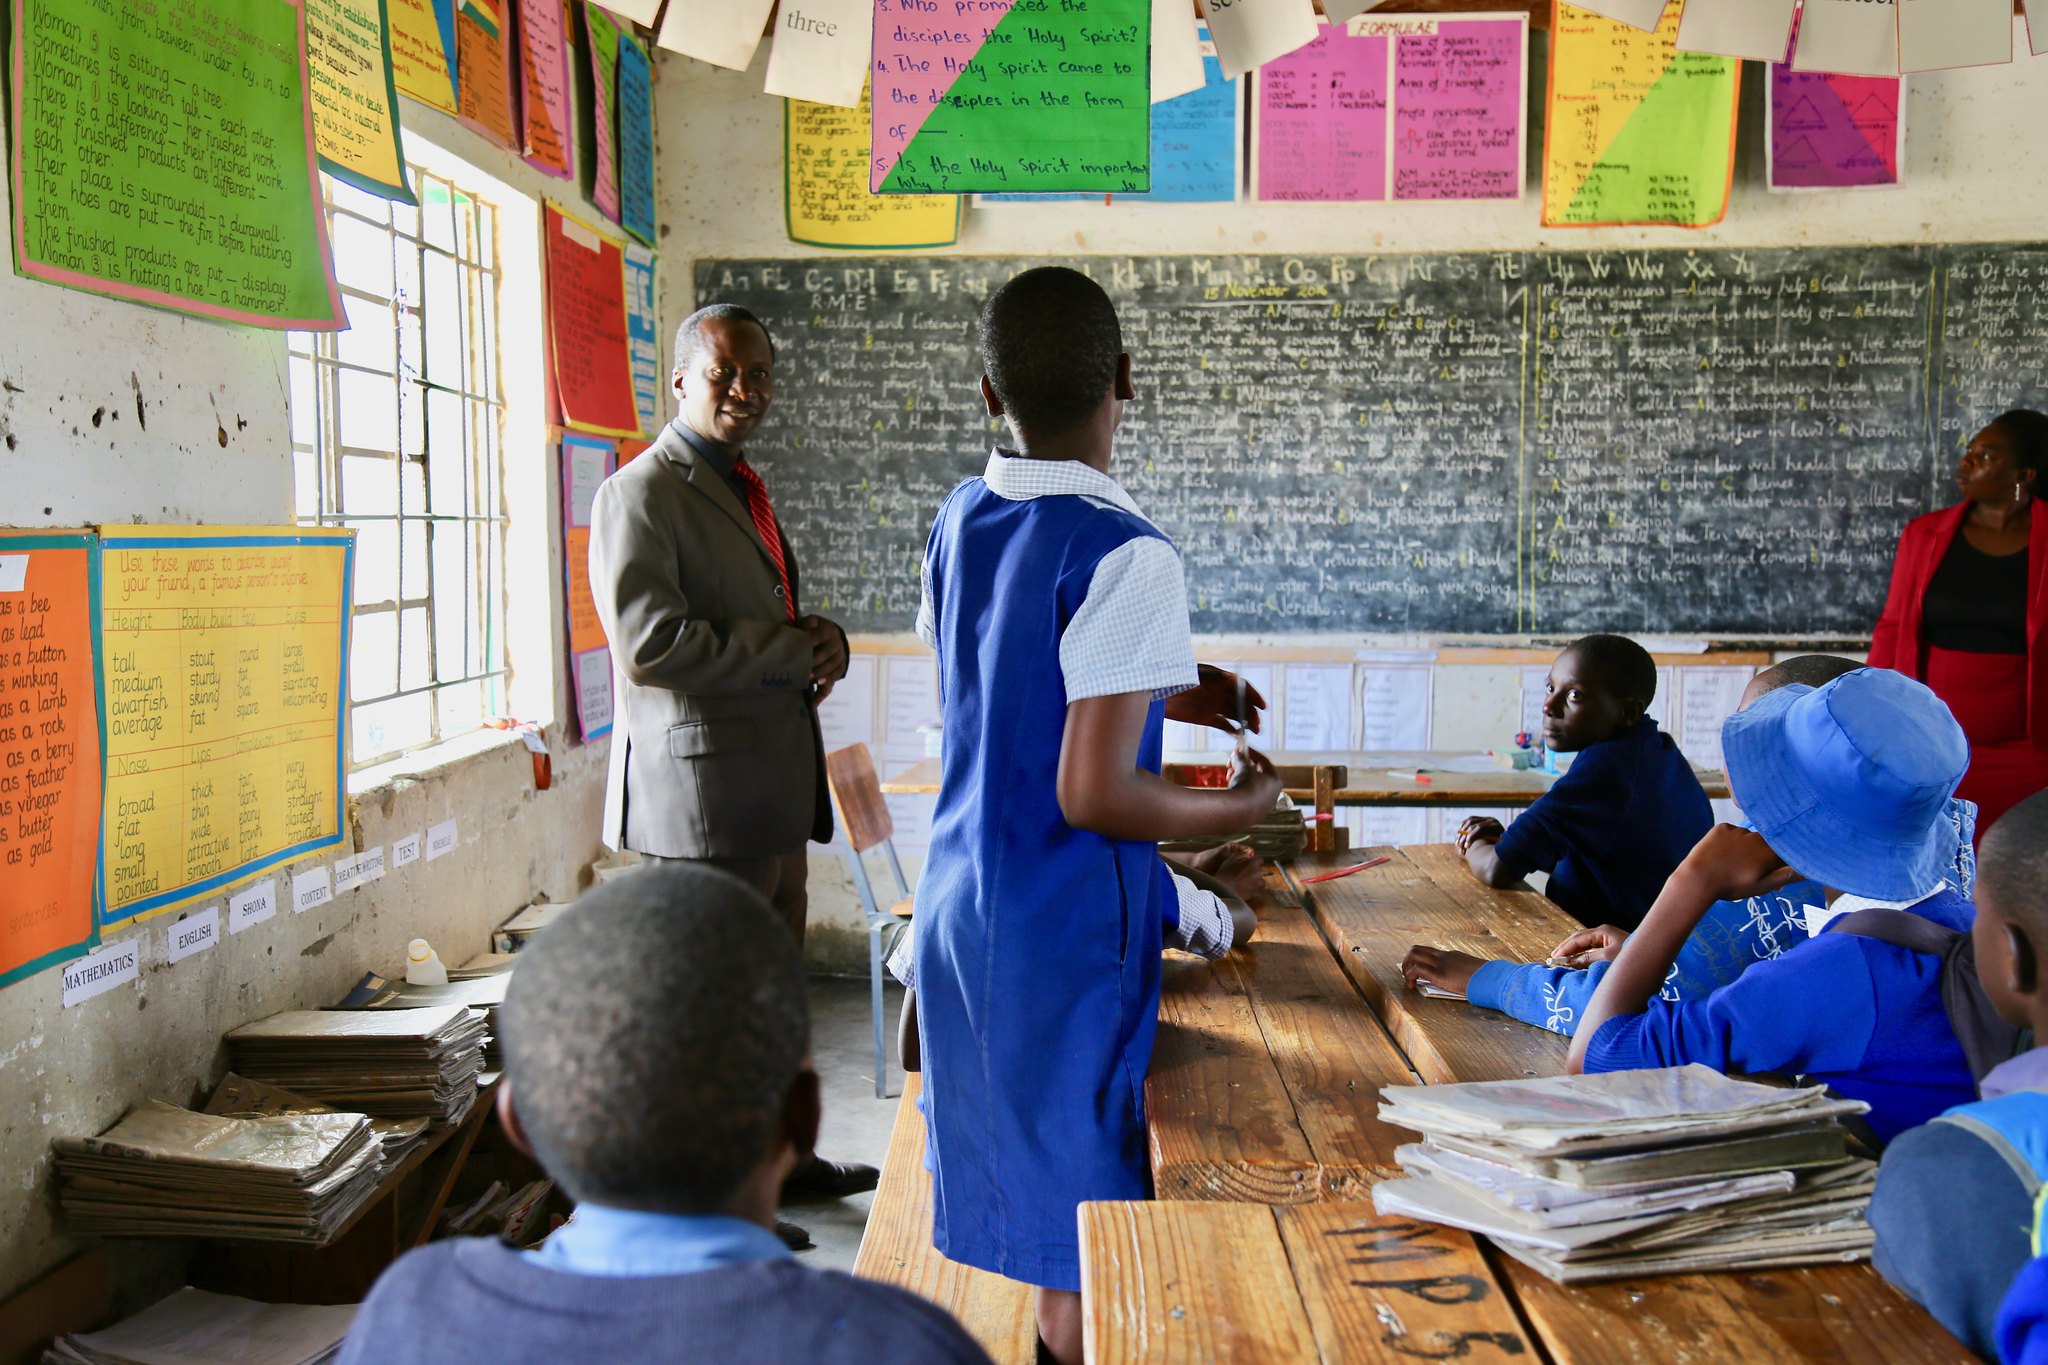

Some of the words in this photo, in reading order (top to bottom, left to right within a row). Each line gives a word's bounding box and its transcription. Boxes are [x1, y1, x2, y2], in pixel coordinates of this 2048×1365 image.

[33, 0, 82, 42] Woman
[955, 0, 1048, 16] promised
[1060, 0, 1088, 13] the
[787, 10, 837, 37] three
[1358, 21, 1434, 36] FORMULAE
[893, 25, 971, 46] disciples
[982, 28, 1012, 45] the
[1028, 27, 1066, 52] Holy
[1080, 26, 1138, 45] Spirit?
[108, 40, 120, 61] is
[128, 54, 169, 91] sitting
[878, 60, 890, 73] 4.
[894, 54, 930, 72] The
[943, 57, 987, 82] Holy
[1113, 62, 1132, 74] to
[33, 25, 99, 76] Sometimes
[109, 63, 131, 89] the
[137, 81, 175, 107] women
[181, 96, 200, 119] talk
[221, 118, 247, 138] each
[33, 48, 82, 91] Woman
[127, 92, 169, 134] looking
[187, 115, 202, 140] her
[206, 129, 248, 158] finished
[892, 87, 918, 103] the
[1012, 91, 1030, 106] in
[1040, 90, 1070, 106] the
[1085, 91, 1124, 109] form
[33, 73, 68, 110] There
[105, 105, 166, 146] difference
[183, 136, 206, 161] their
[210, 151, 251, 178] finished
[889, 125, 907, 141] of
[33, 98, 66, 131] Their
[74, 118, 128, 151] finished
[137, 144, 186, 173] products
[193, 165, 209, 184] are
[212, 169, 257, 200] different
[34, 127, 63, 155] each
[897, 151, 916, 173] Is
[930, 155, 962, 174] the
[970, 158, 1007, 181] Holy
[1018, 157, 1070, 177] Spirit
[33, 144, 68, 176] Their
[80, 164, 114, 195] place
[141, 188, 206, 220] surrounded
[70, 180, 100, 211] hoes
[109, 199, 131, 219] are
[138, 207, 159, 230] put
[195, 221, 213, 246] fire
[218, 228, 246, 256] before
[250, 237, 292, 269] hitting
[39, 238, 85, 271] Woman
[130, 261, 171, 294] hitting
[187, 276, 204, 297] hoe
[66, 226, 117, 257] finished
[125, 245, 177, 270] products
[207, 266, 223, 288] put
[1224, 282, 1289, 299] November
[121, 551, 144, 573] Use
[152, 552, 178, 572] these
[187, 556, 215, 573] words
[222, 556, 233, 571] to
[122, 577, 150, 601] your
[212, 574, 242, 596] famous
[30, 592, 51, 614] bee
[2, 627, 15, 643] as
[20, 614, 45, 640] lead
[111, 610, 153, 638] Height
[181, 608, 206, 636] Body
[27, 641, 67, 664] button
[112, 651, 136, 673] tall
[190, 649, 215, 667] stout
[12, 664, 58, 695] winking
[112, 672, 163, 694] medium
[190, 670, 221, 691] sturdy
[0, 702, 13, 718] as
[38, 688, 67, 712] lamb
[112, 691, 168, 717] dwarfish
[189, 688, 220, 711] skinny
[0, 727, 16, 743] as
[40, 712, 66, 736] rock
[112, 716, 163, 741] average
[189, 709, 206, 733] fat
[7, 751, 24, 768] as
[46, 739, 74, 765] berry
[117, 755, 150, 776] Nose
[191, 747, 211, 769] Lips
[1, 776, 20, 793] as
[25, 762, 67, 799] feather
[18, 790, 62, 816] vinegar
[118, 790, 155, 817] broad
[191, 778, 214, 801] thick
[19, 815, 54, 839] butter
[115, 816, 140, 847] flat
[191, 803, 210, 821] thin
[7, 848, 23, 865] as
[30, 830, 53, 868] gold
[119, 838, 145, 863] long
[190, 820, 211, 841] wide
[399, 842, 416, 861] TEST
[114, 854, 146, 884] small
[186, 835, 229, 863] attractive
[362, 855, 384, 875] WRITING
[116, 871, 159, 909] pointed
[186, 854, 221, 881] smooth
[300, 886, 328, 906] CONTENT
[242, 897, 267, 917] SHONA
[178, 923, 212, 950] ENGLISH
[64, 953, 134, 992] MATHEMATICS
